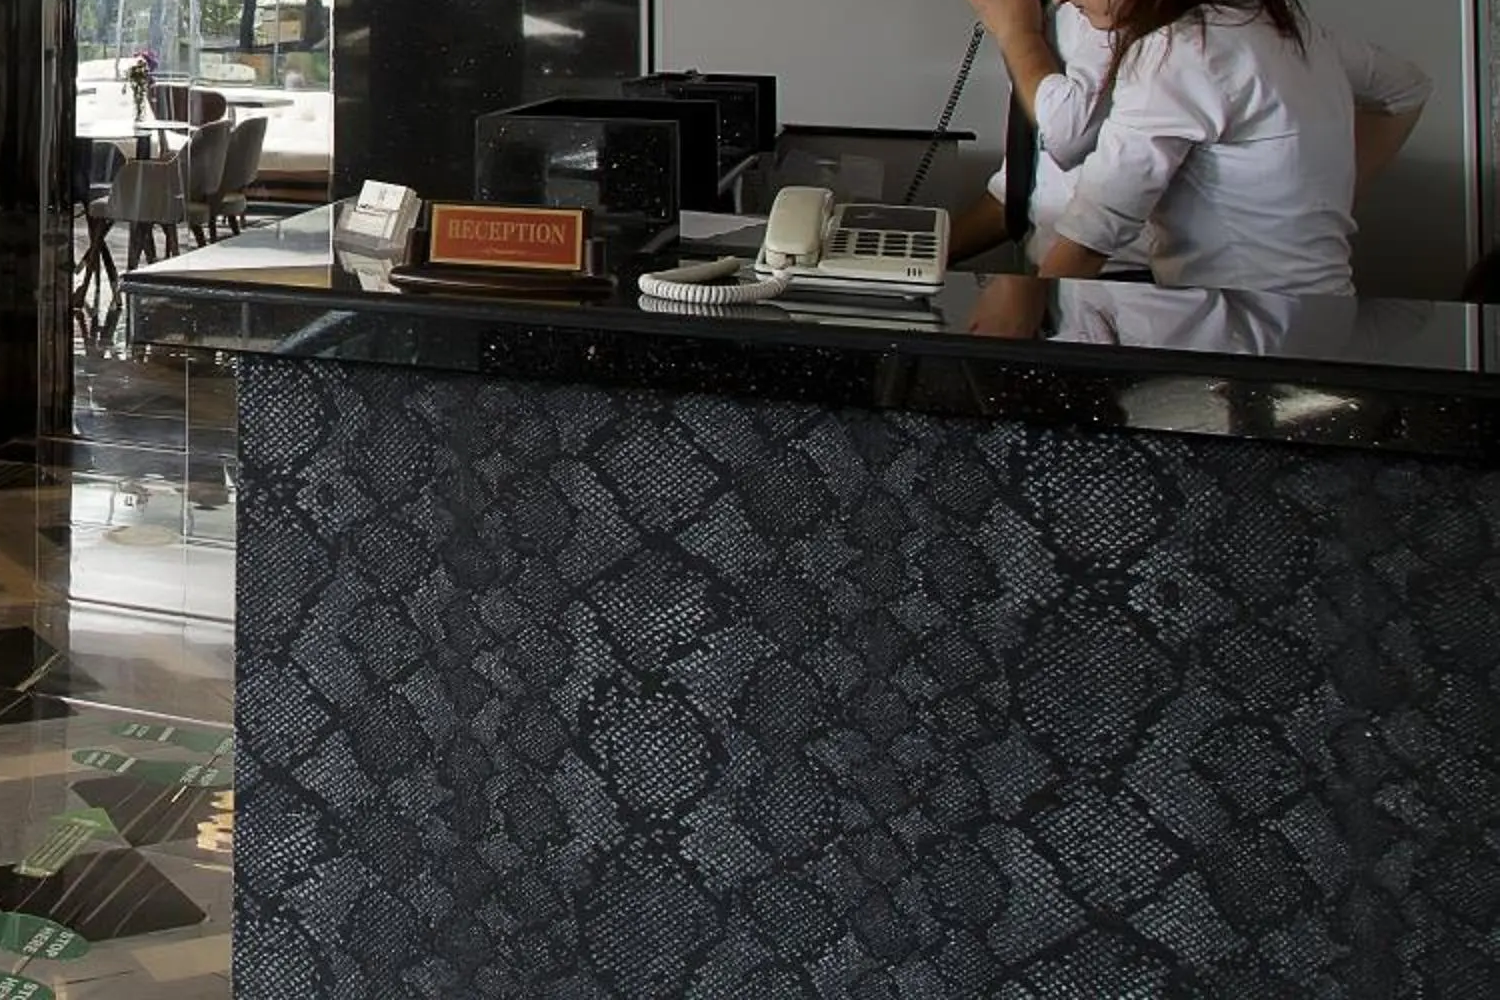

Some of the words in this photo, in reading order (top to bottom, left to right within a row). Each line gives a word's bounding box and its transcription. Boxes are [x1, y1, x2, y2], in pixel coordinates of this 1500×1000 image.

[449, 219, 566, 245] RECEPTION
[23, 927, 54, 954] HERE
[46, 931, 75, 958] STOP
